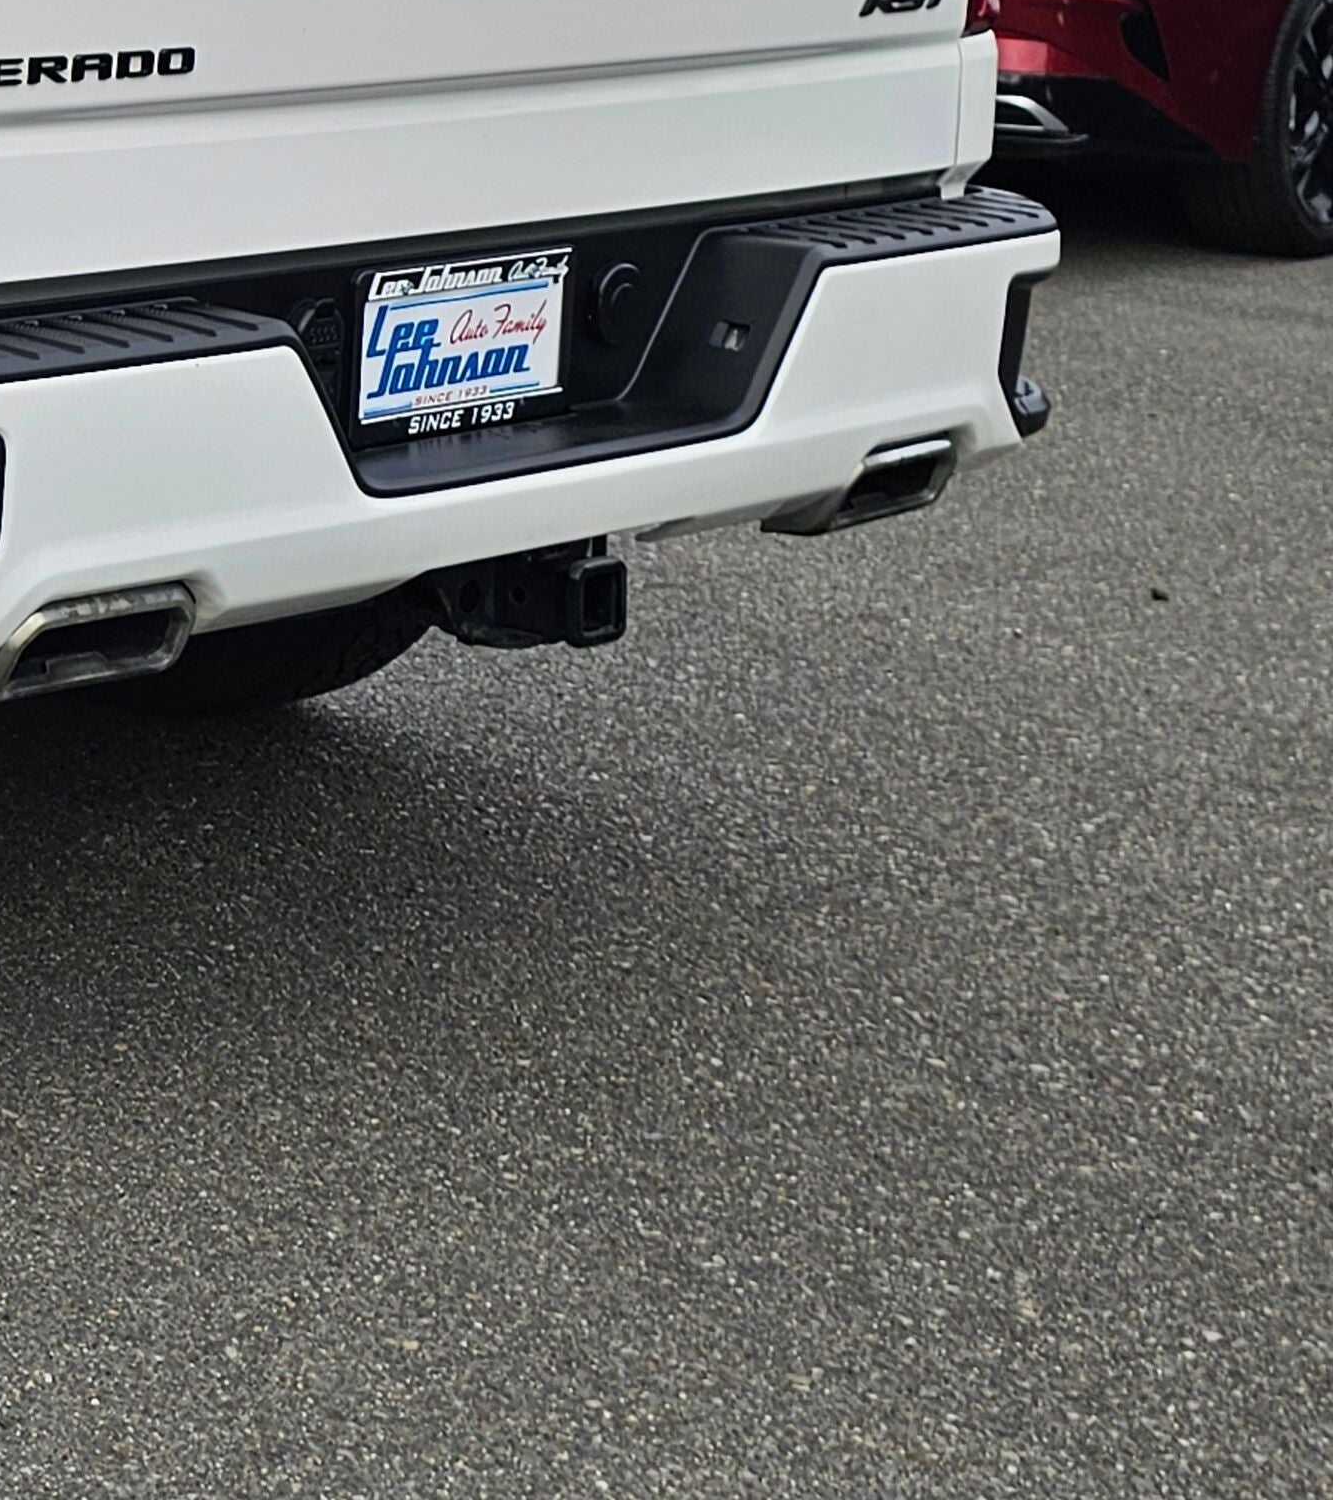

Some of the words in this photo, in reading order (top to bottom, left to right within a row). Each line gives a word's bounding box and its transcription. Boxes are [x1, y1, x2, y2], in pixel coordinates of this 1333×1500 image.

[368, 272, 416, 301] Lee
[409, 264, 502, 296] Johnson
[366, 304, 441, 358] Lee
[450, 309, 488, 344] Auto
[493, 299, 547, 344] Family
[367, 342, 531, 399] Johnson
[414, 391, 453, 406] SINCE
[458, 385, 488, 398] 1933
[408, 408, 464, 435] SINCE
[471, 401, 515, 425] 1933
